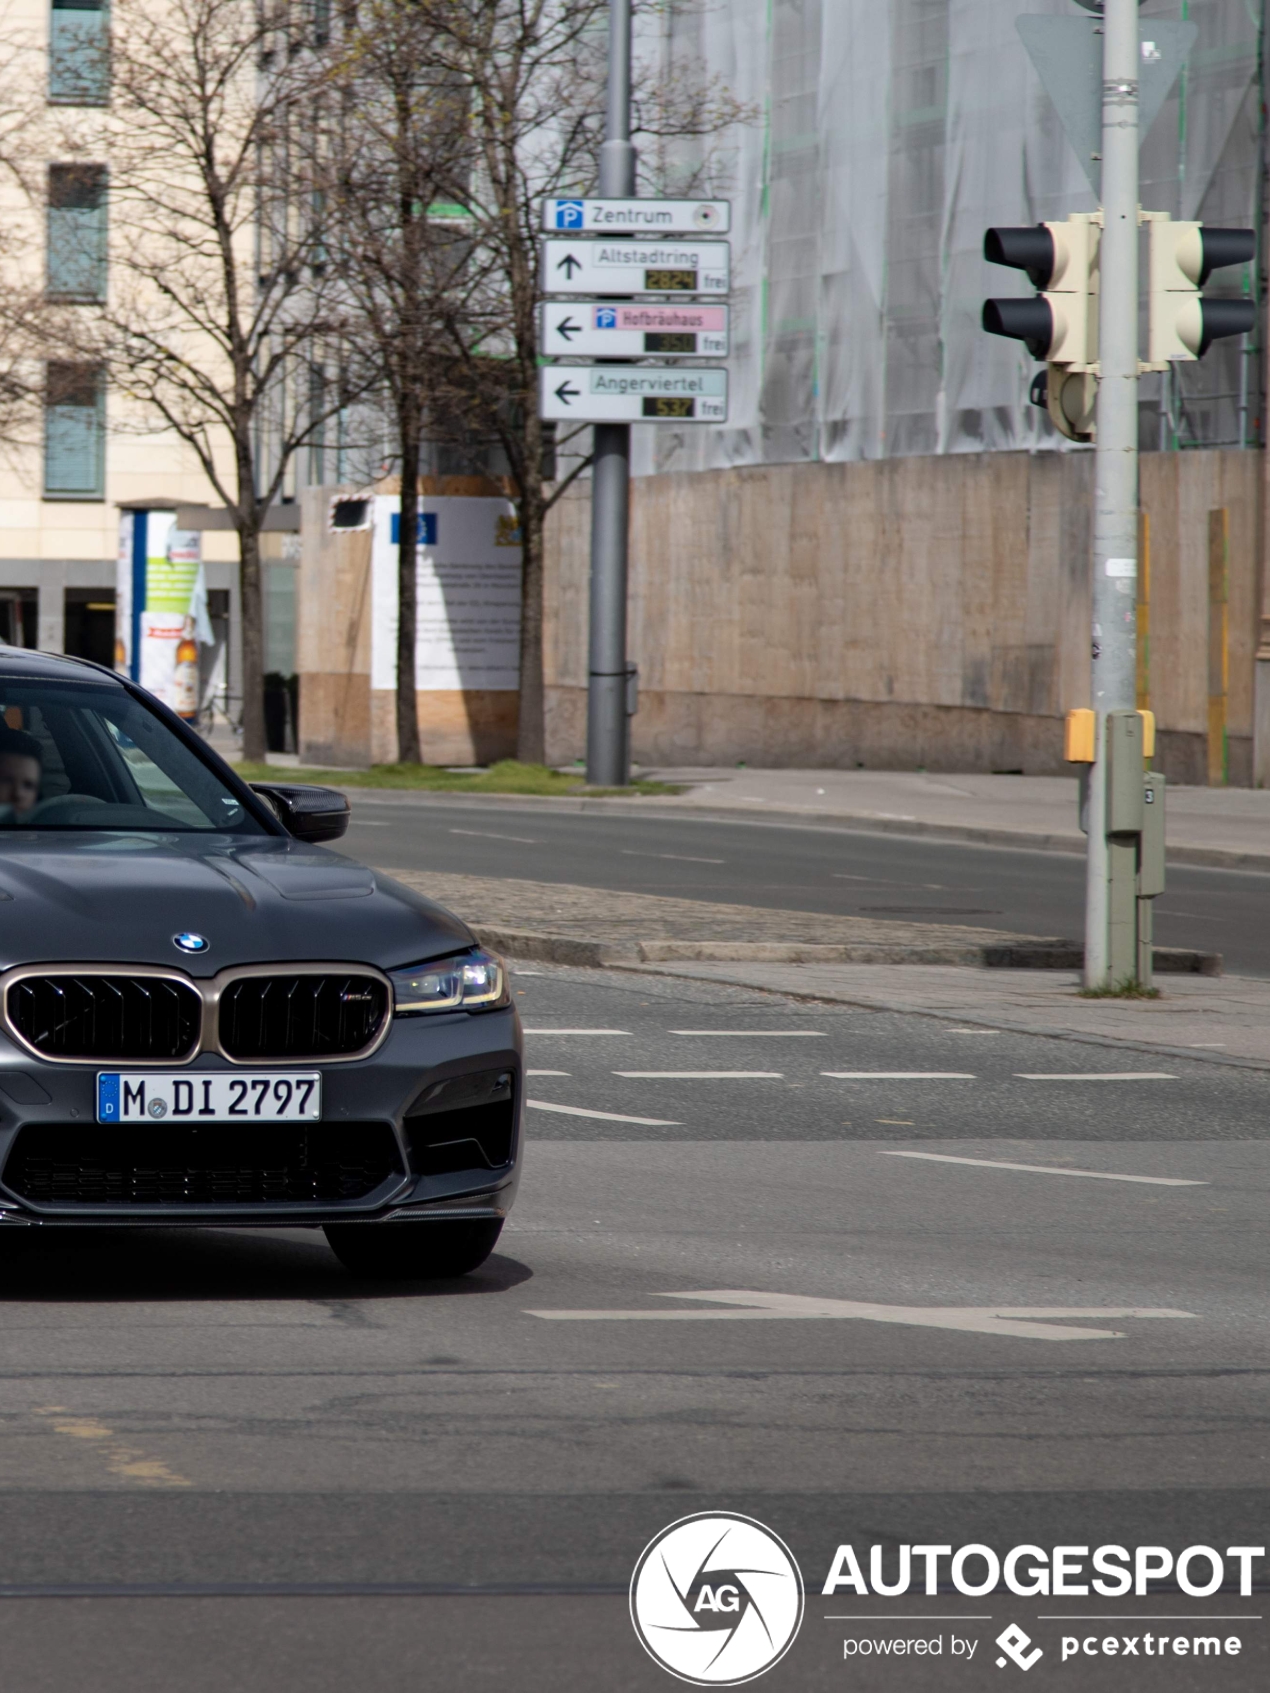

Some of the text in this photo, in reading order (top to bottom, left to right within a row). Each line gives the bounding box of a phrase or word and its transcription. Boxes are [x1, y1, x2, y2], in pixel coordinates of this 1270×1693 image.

[592, 206, 673, 224] Zentrum
[598, 249, 699, 268] Altstadtring
[647, 271, 694, 289] 2824
[704, 275, 726, 289] frei
[622, 311, 704, 327] Hofbräuhaus
[704, 337, 725, 350] frei
[595, 375, 704, 394] Angerviertel
[656, 398, 692, 416] 537
[702, 402, 723, 416] frei
[1146, 790, 1154, 802] 3
[123, 1079, 315, 1116] M DI 2797
[105, 1103, 114, 1114] D
